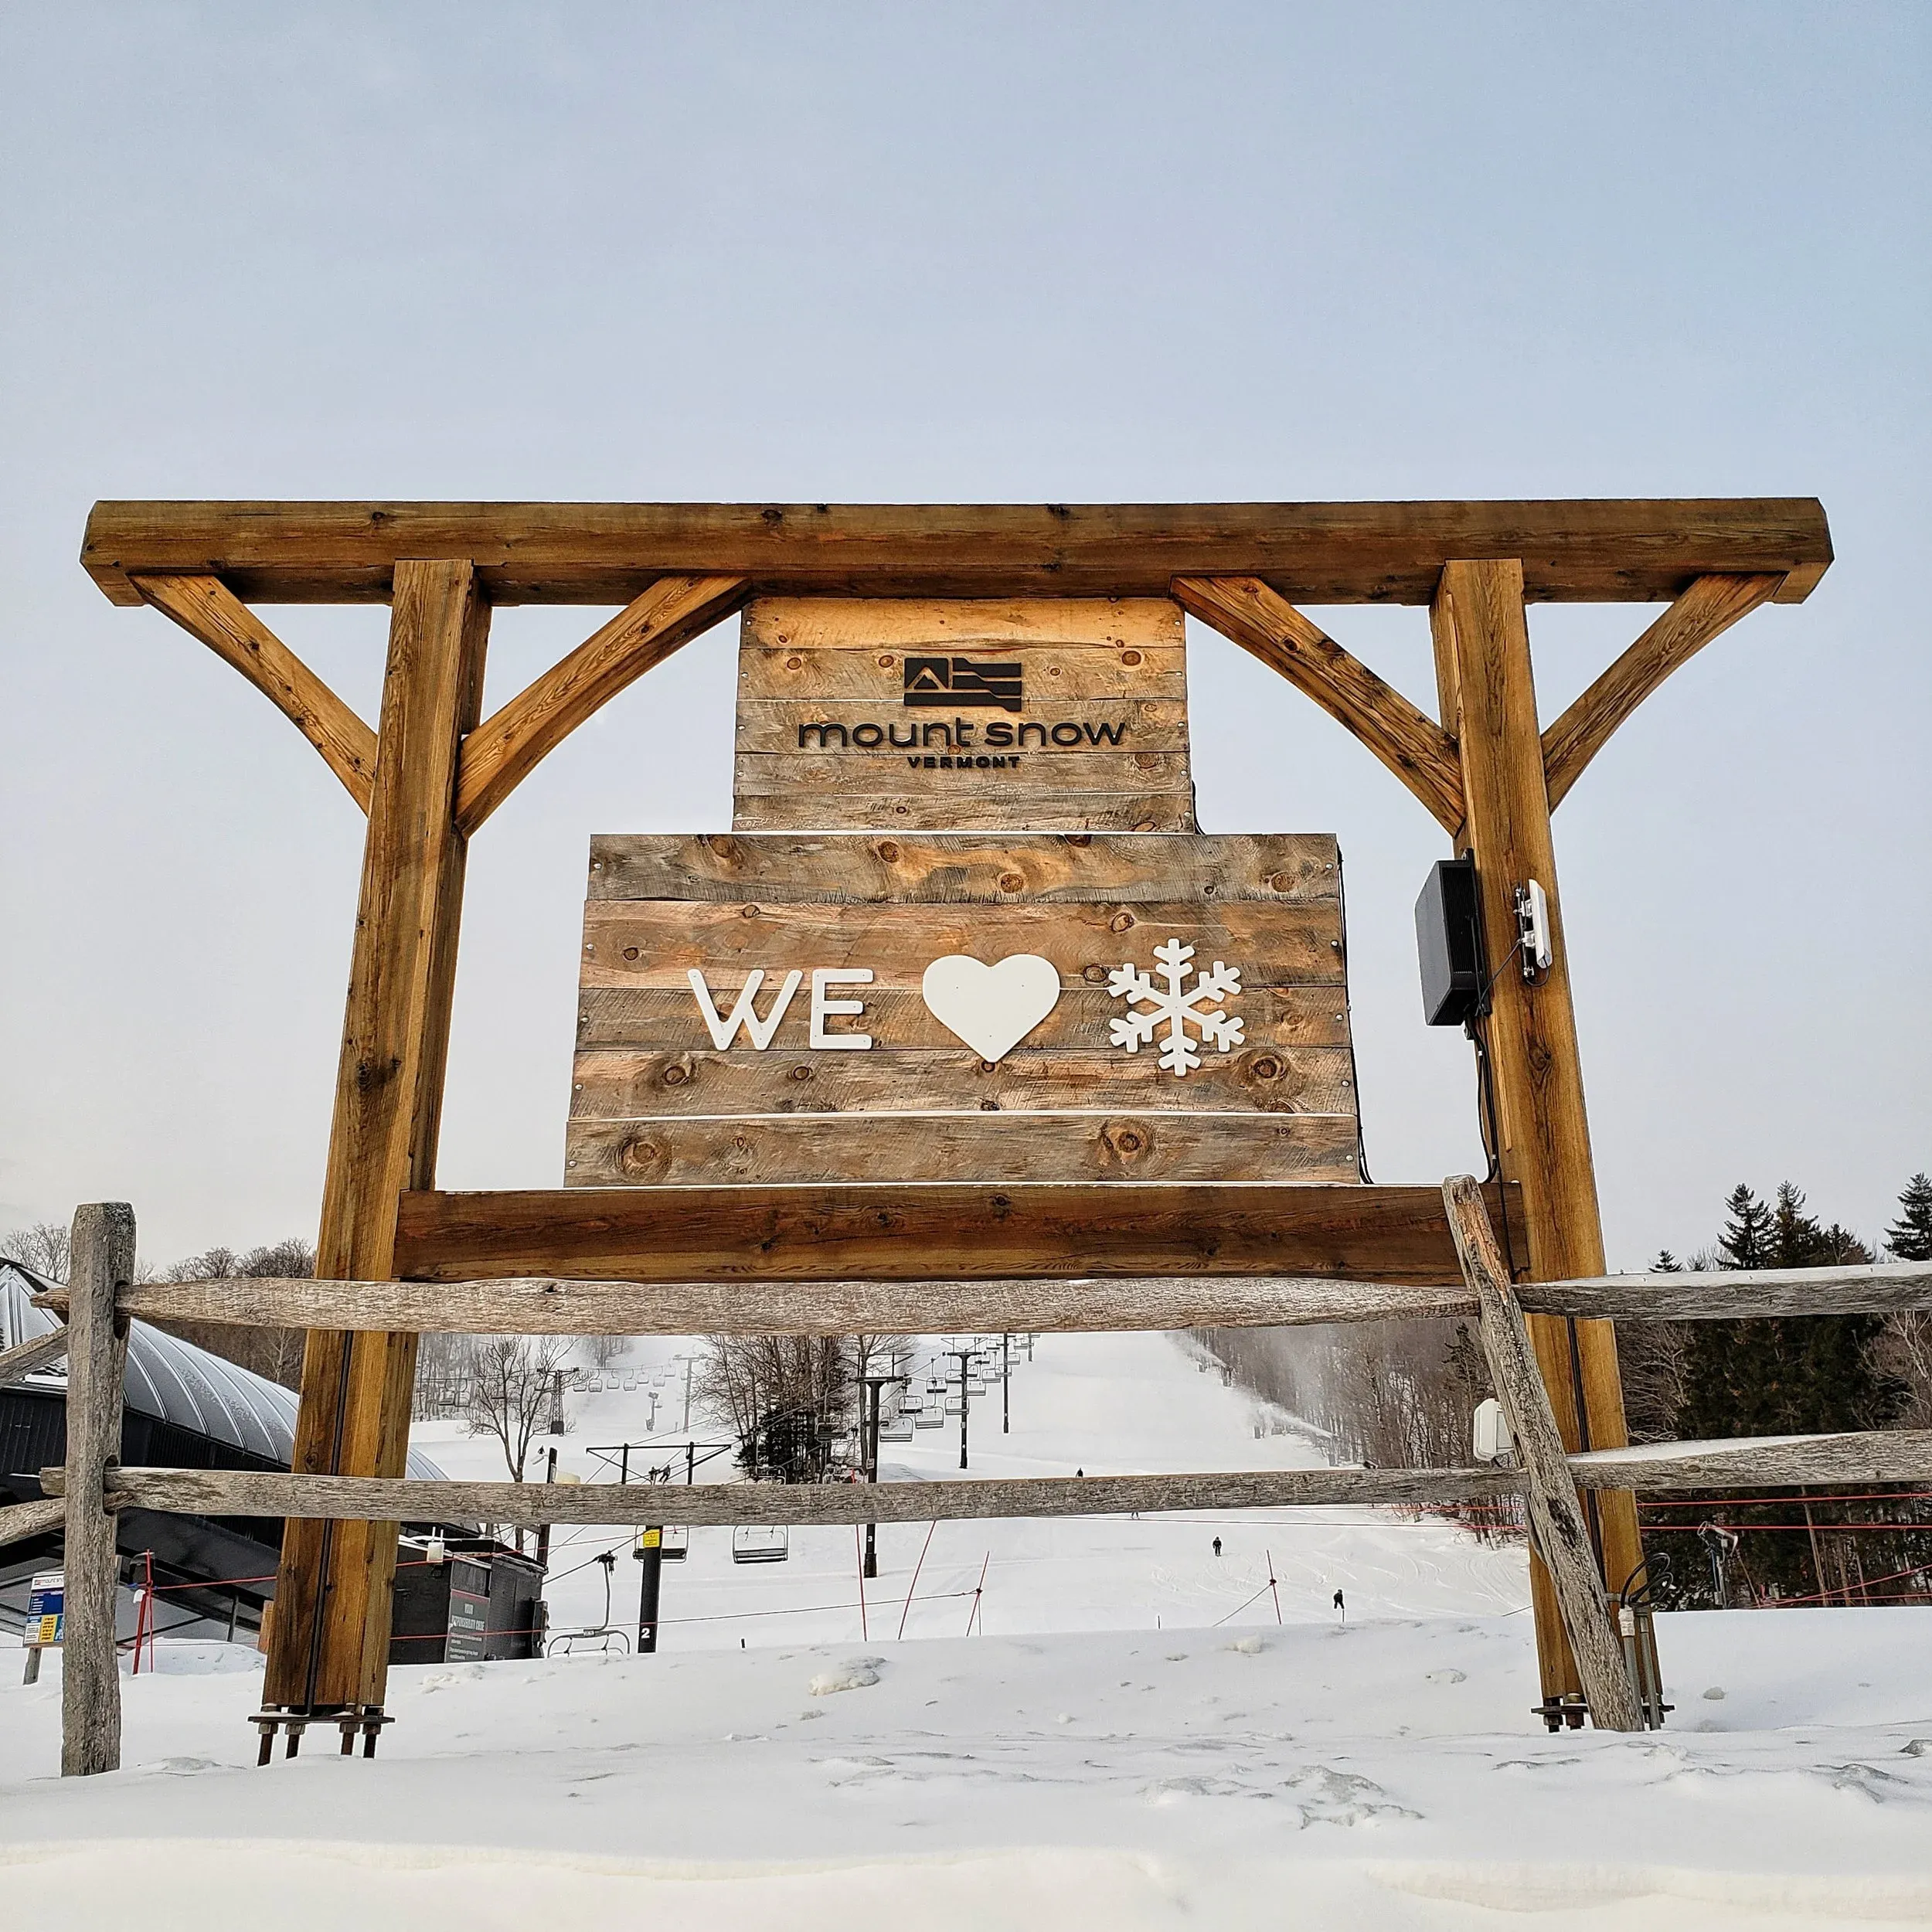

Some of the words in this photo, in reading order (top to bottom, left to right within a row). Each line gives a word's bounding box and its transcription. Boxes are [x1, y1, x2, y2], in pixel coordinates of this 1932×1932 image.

[798, 717, 975, 749] mount
[985, 722, 1127, 747] snow
[907, 756, 1020, 769] VERMONT
[687, 968, 873, 1051] WE
[641, 1628, 650, 1638] 2
